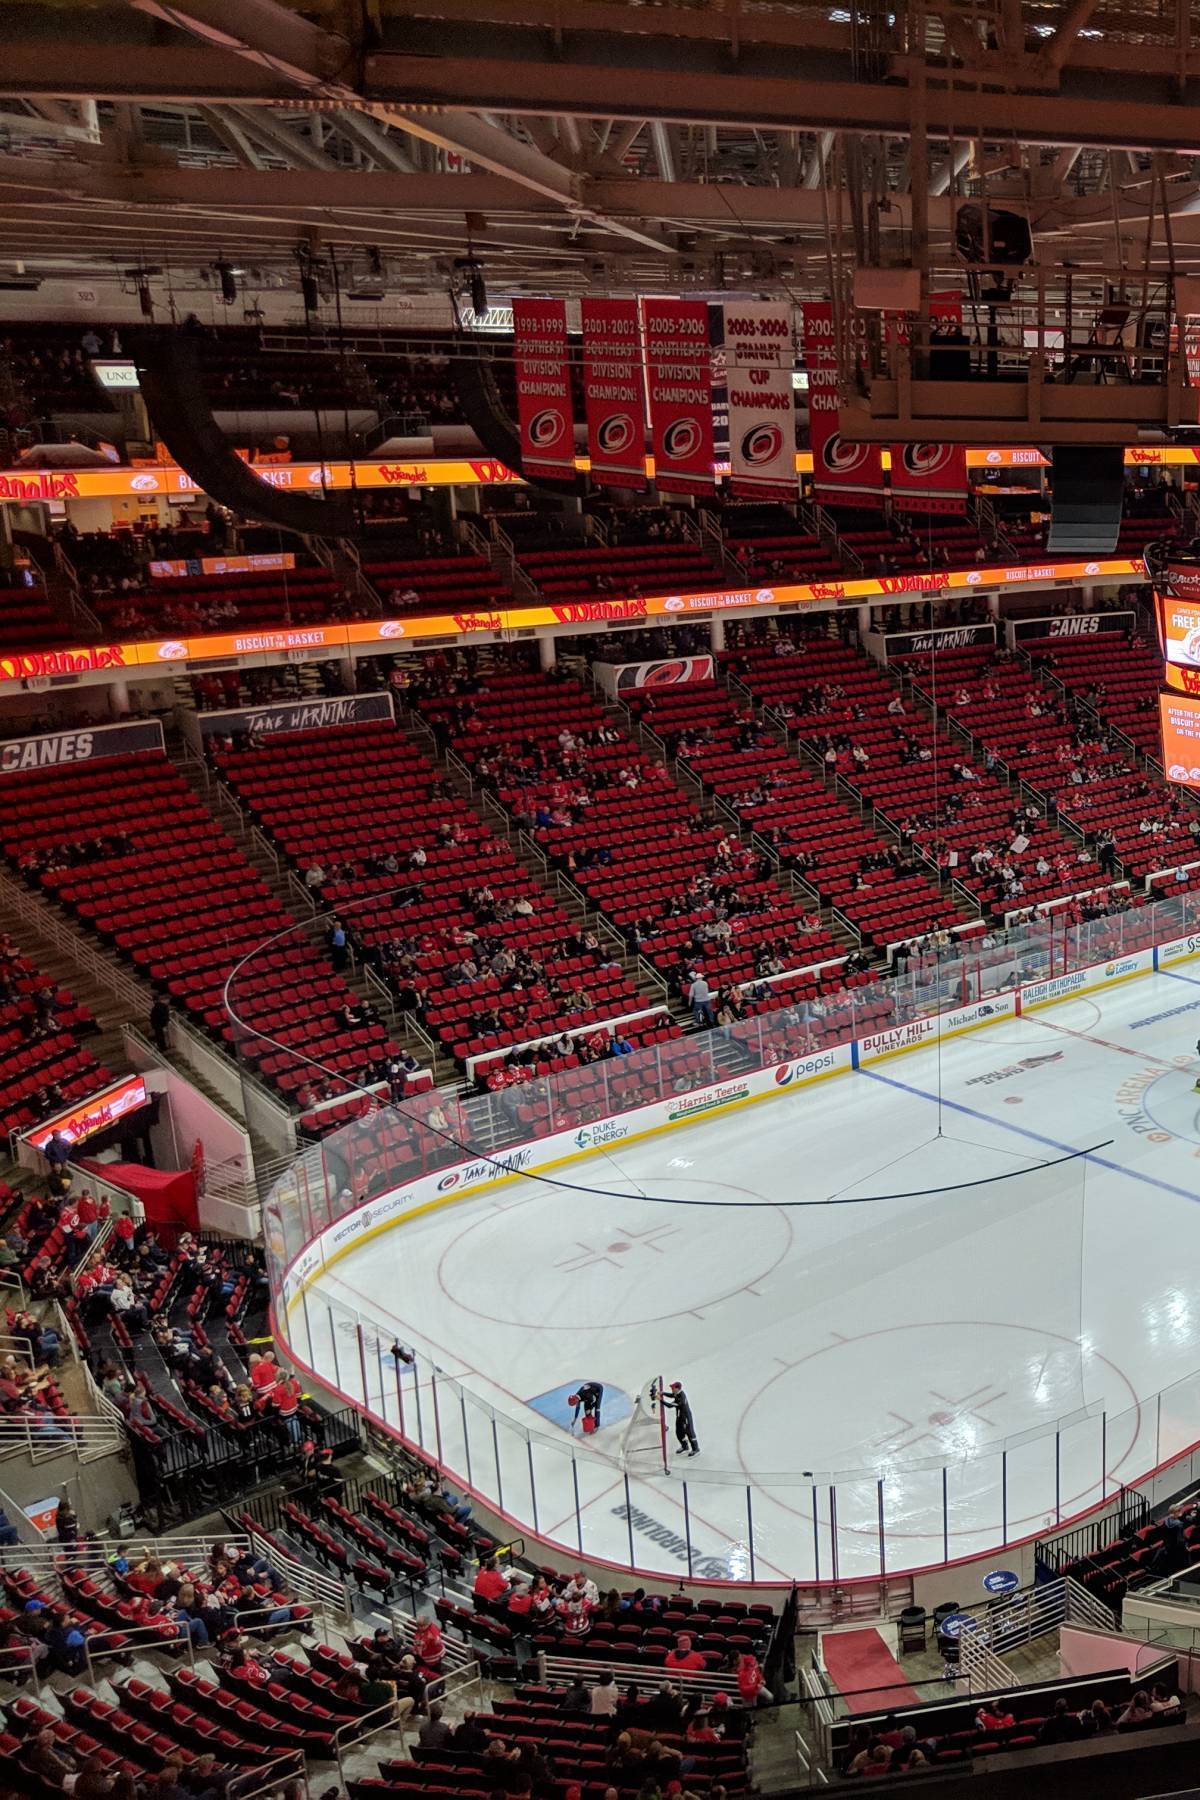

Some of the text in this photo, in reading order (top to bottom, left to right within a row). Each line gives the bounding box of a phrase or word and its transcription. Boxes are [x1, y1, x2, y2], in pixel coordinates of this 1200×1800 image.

[517, 318, 564, 333] 1998-1999
[584, 319, 635, 334] 2001-2002
[650, 318, 705, 335] 2005-2006
[727, 319, 789, 337] 2005-2006
[736, 342, 781, 361] STANLEY
[523, 362, 561, 376] DIVISION
[592, 364, 632, 379] DIVISION
[658, 365, 701, 381] DIVISION
[749, 370, 770, 385] CUP
[653, 388, 709, 405] CHAMPIONS
[730, 391, 790, 410] CHAMPIONS
[1012, 451, 1040, 463] BISCUIT
[378, 466, 428, 484] Bojangles
[1006, 568, 1056, 580] BISCUIT BASKET
[690, 593, 752, 608] BISCUIT BASKET
[453, 613, 502, 632] Bojangles
[1050, 616, 1100, 636] CANES
[1172, 614, 1195, 628] FREE
[236, 631, 325, 651] BISCUIT BASKET
[911, 629, 976, 651] TAKE WARNING
[245, 700, 359, 732] TAKE WARNING
[1168, 708, 1184, 716] AFTER
[1184, 710, 1194, 718] THE
[1170, 716, 1194, 728] BISCUIT
[1185, 729, 1195, 737] THE
[2, 734, 94, 770] CANES
[1115, 960, 1139, 976] Lottery
[1022, 972, 1087, 1001] RALEIGH ORTHOPAEDIC
[1050, 991, 1063, 1000] TEAM
[948, 1001, 1010, 1028] Michael Son
[863, 1021, 934, 1052] BULLY HILL
[875, 1035, 923, 1055] VINEYARDS
[796, 1052, 835, 1080] pepsi
[678, 1091, 713, 1110] Harris
[715, 1082, 748, 1098] Teeter
[1115, 1067, 1162, 1135] PNC ARENA
[69, 1104, 114, 1139] Bojangles
[592, 1120, 617, 1136] DUKE
[593, 1126, 629, 1146] ENERGY
[462, 1149, 534, 1183] TAKE WARNING
[333, 1193, 414, 1243] VECTOR SECURITY
[242, 1405, 252, 1417] 11
